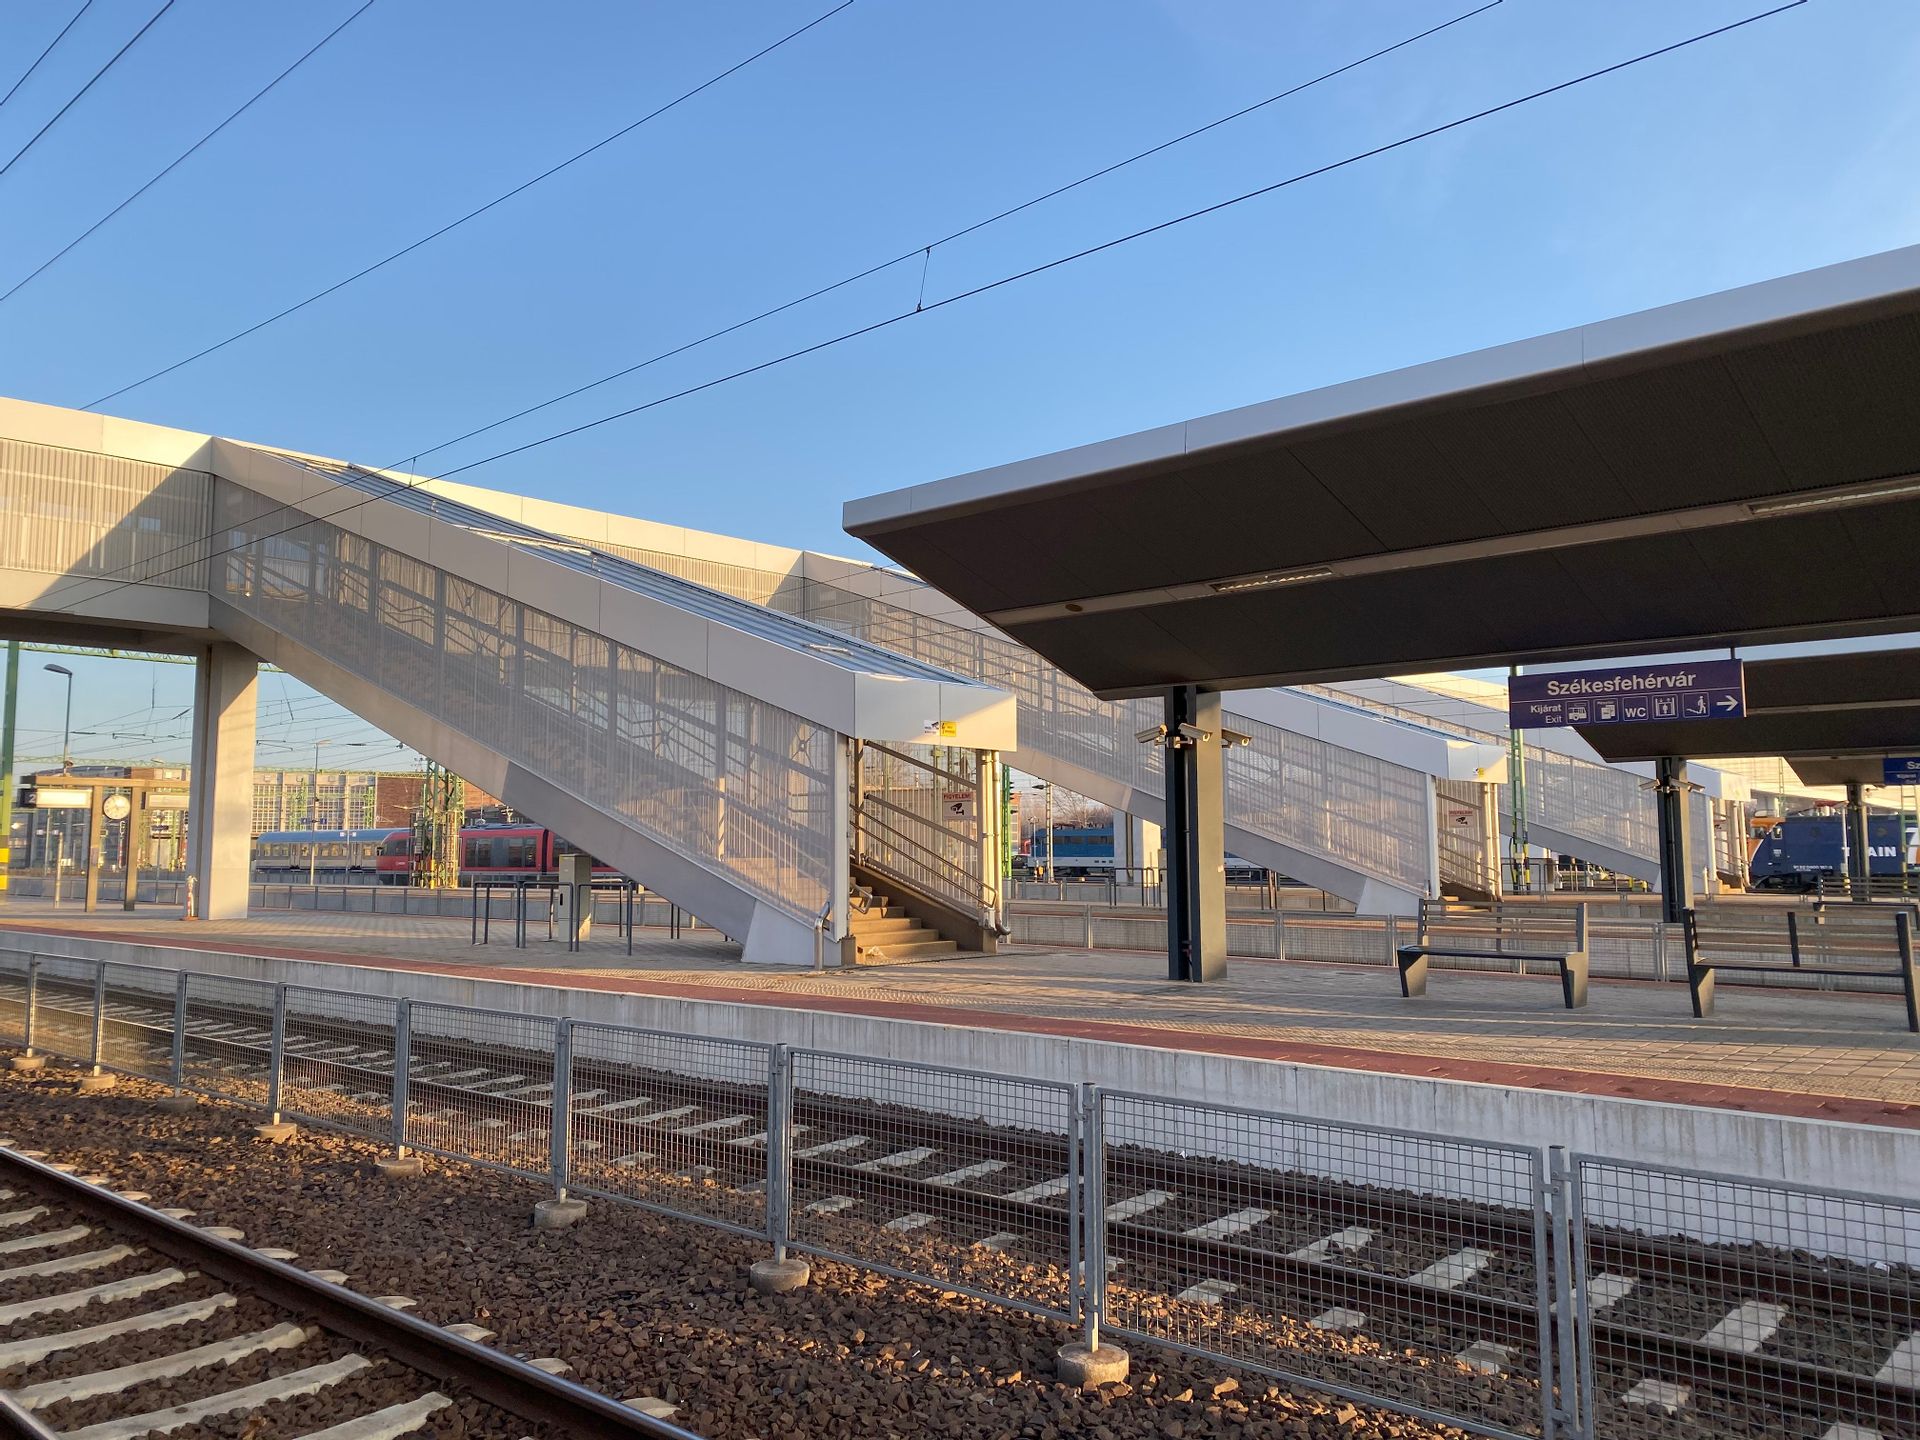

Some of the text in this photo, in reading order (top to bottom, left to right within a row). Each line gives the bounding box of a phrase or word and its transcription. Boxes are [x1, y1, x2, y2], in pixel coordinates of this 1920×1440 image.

[1547, 671, 1696, 695] Székesfehérvár
[1530, 703, 1562, 715] Kijárat
[1625, 707, 1646, 718] WC
[1545, 715, 1562, 724] Exit
[1842, 846, 1896, 857] TAIN
